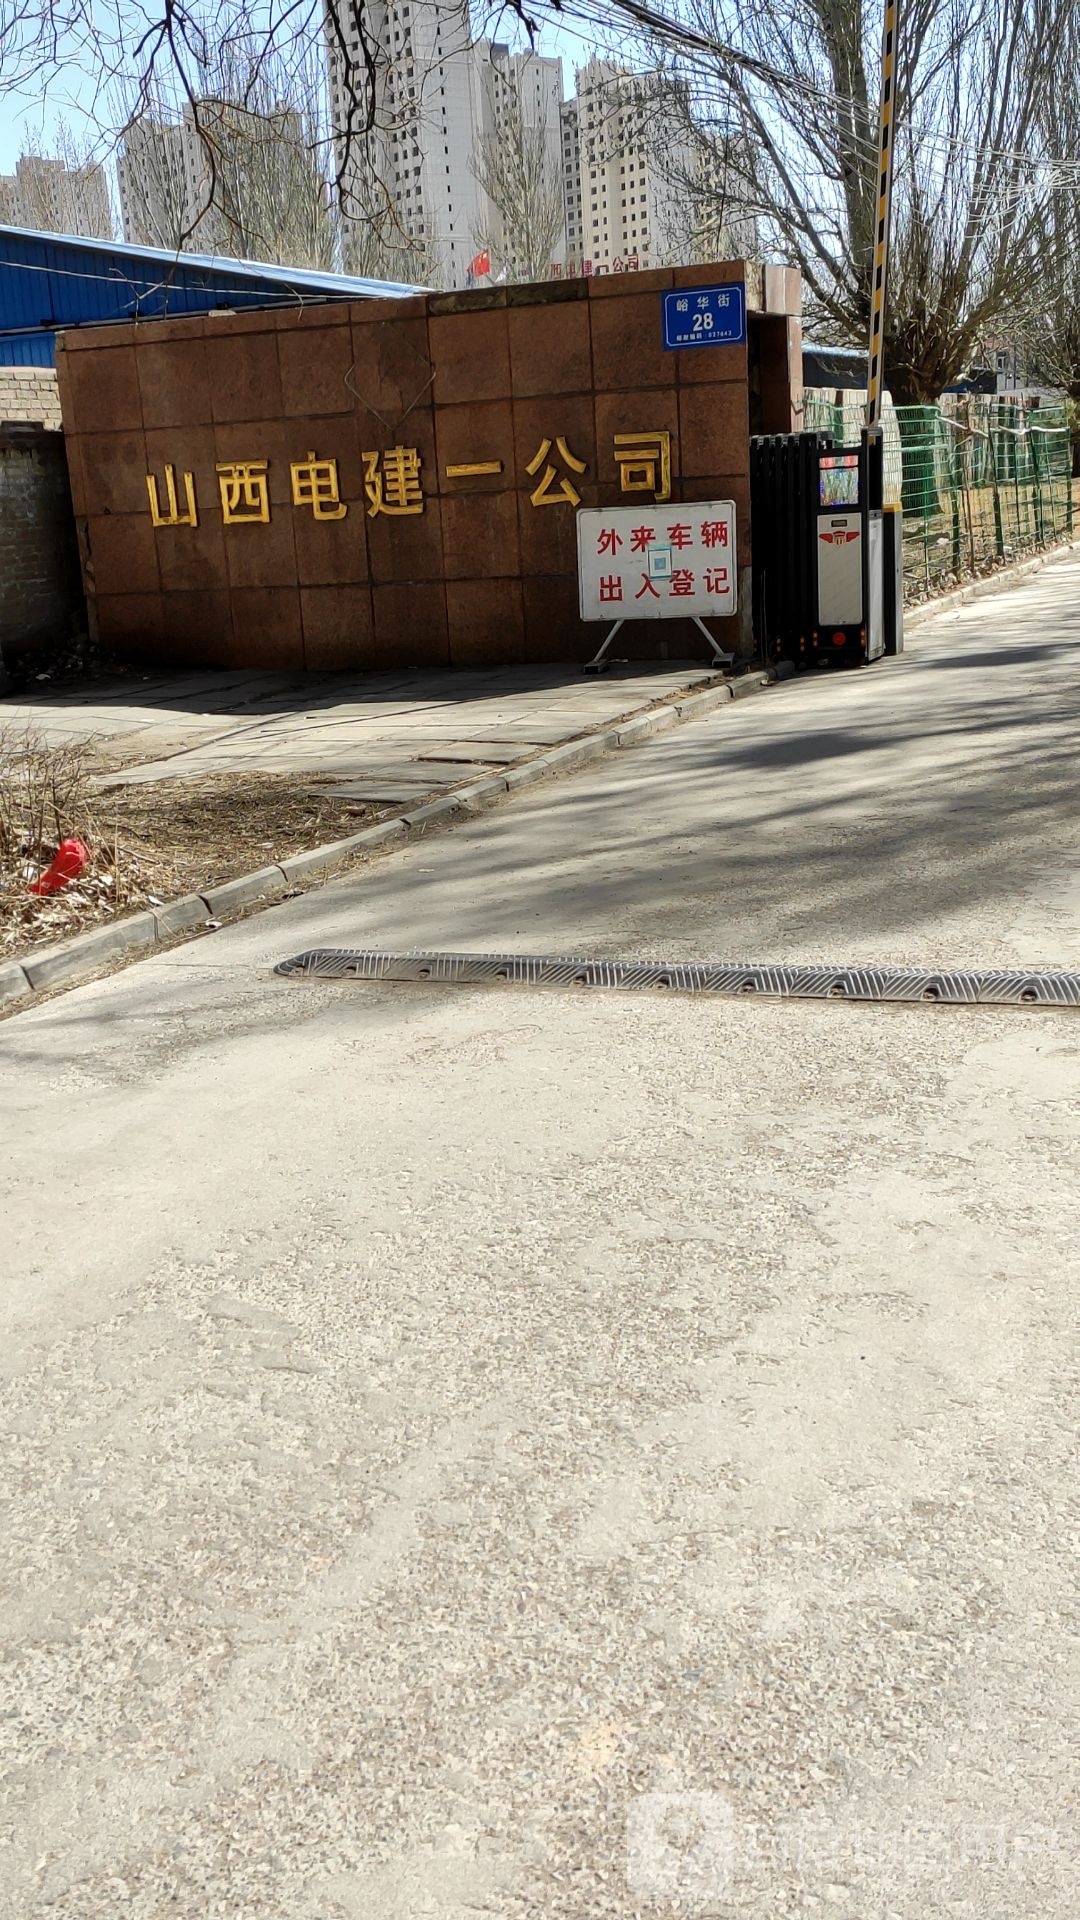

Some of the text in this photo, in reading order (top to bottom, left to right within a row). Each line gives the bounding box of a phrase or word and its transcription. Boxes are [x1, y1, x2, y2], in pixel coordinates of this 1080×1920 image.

[692, 312, 714, 332] 28
[145, 431, 671, 528] 山西电建一公司
[597, 521, 728, 556] 外来车辆
[599, 567, 730, 602] 出入登记
